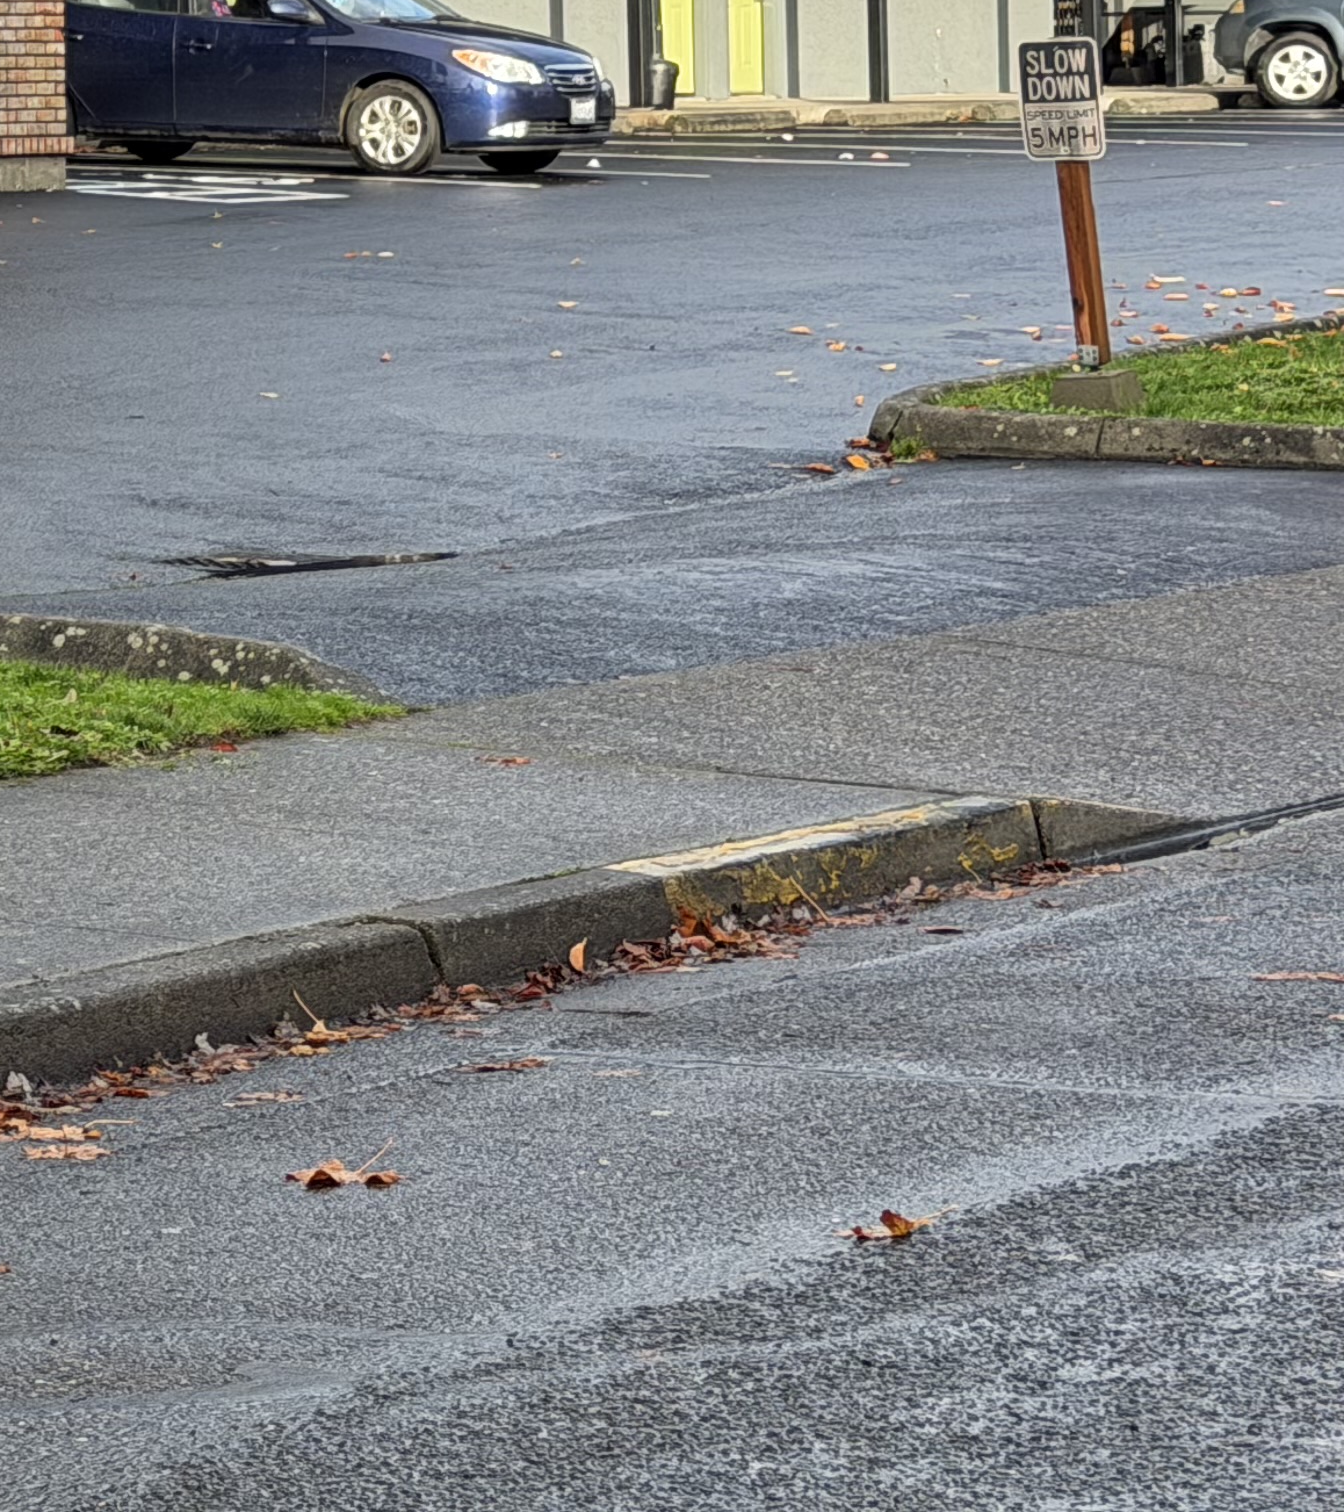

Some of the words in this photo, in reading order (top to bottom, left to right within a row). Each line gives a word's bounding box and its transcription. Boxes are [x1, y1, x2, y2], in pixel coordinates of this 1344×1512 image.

[1026, 49, 1087, 74] SLOW
[1027, 75, 1090, 101] DOWN
[1027, 110, 1063, 121] SPEED
[1066, 108, 1095, 119] LIMIT
[1031, 127, 1044, 148] 5
[1048, 126, 1097, 147] MPH
